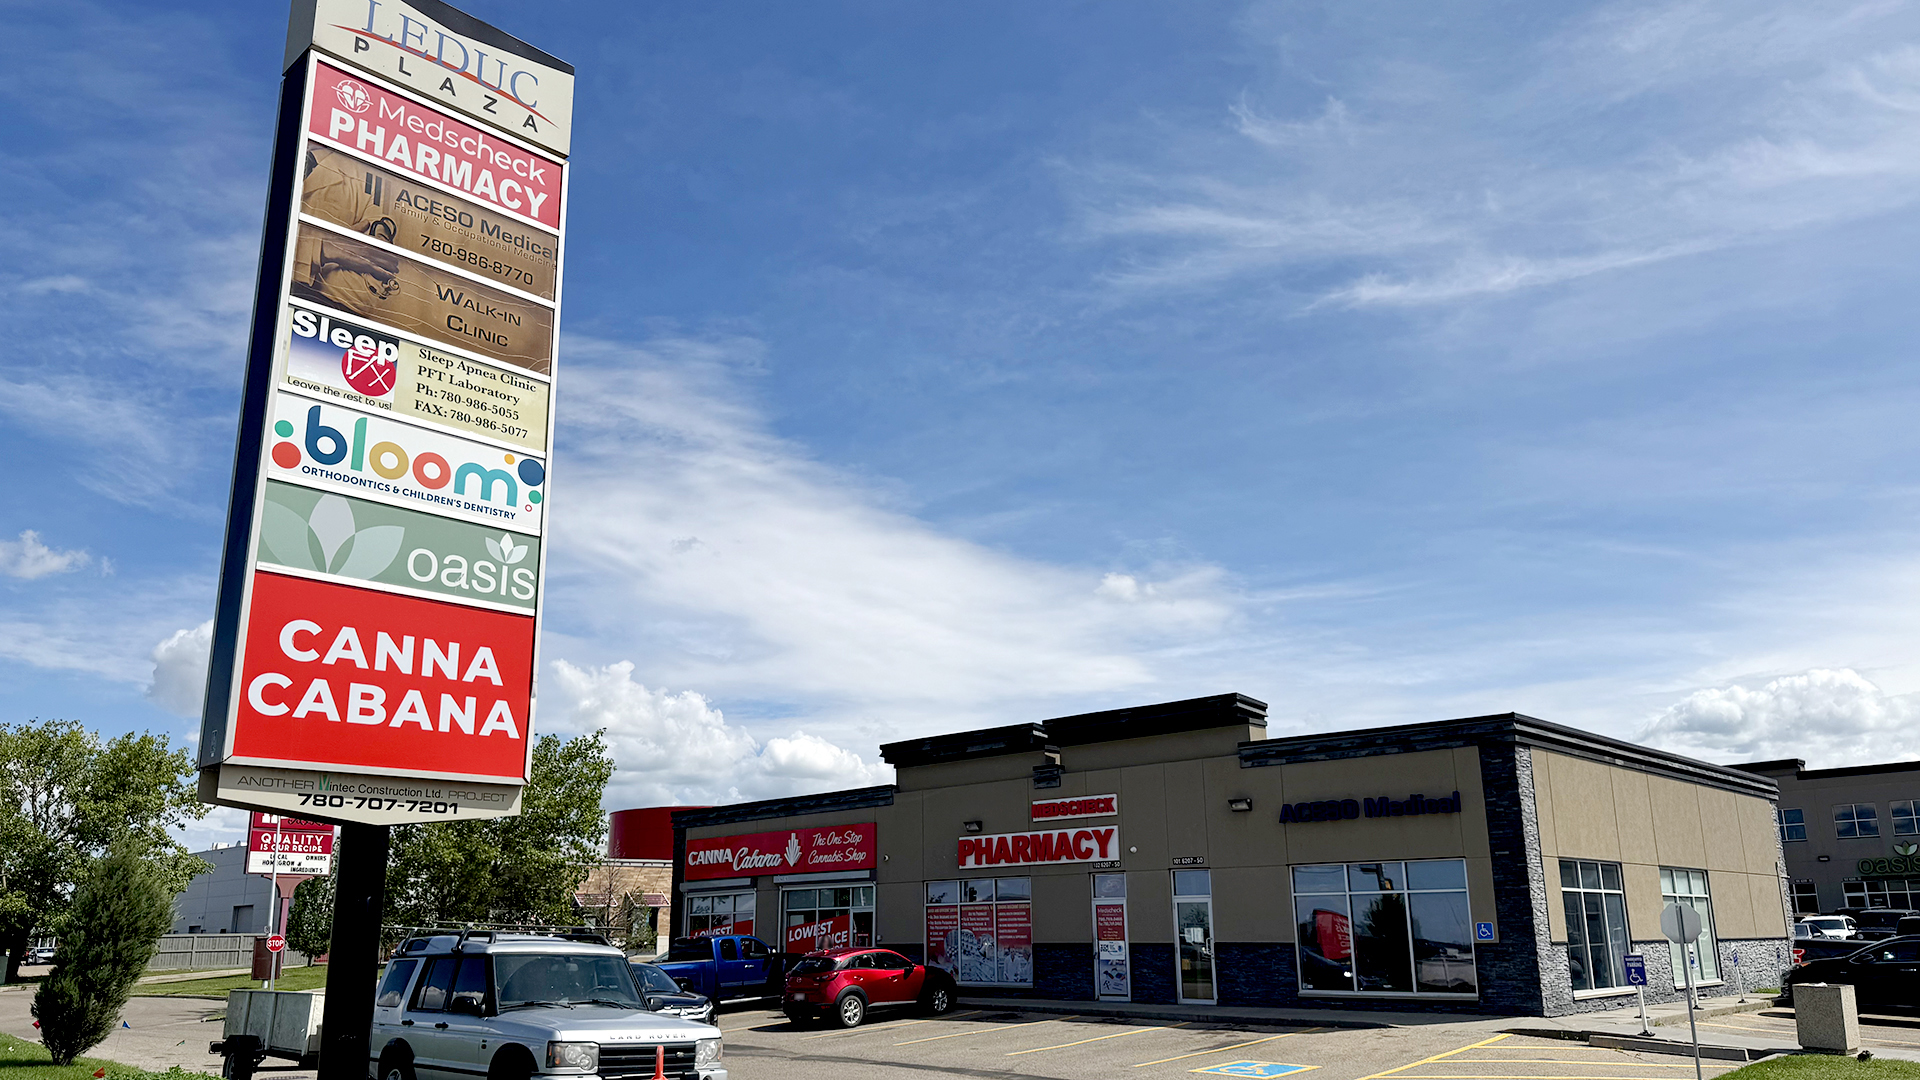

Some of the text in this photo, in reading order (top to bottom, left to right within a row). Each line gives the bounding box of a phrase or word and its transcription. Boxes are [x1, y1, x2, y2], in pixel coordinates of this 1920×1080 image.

[361, 0, 539, 108] LEDUC
[354, 36, 538, 133] PLAZA
[379, 97, 546, 186] Medscheck
[329, 107, 548, 219] PHARMACY
[396, 189, 474, 229] ACESO
[394, 202, 556, 270] Family & Occupational Medicine
[420, 234, 533, 285] 780-986-8770
[435, 284, 521, 326] WALK-IN
[292, 310, 399, 365] Sleep
[446, 314, 509, 347] CLINIC
[417, 365, 521, 405] PFT Laboratory
[419, 348, 537, 393] Sleep Apnea Clinic
[287, 376, 393, 411] Leave the rest to us!
[416, 383, 520, 421] Ph: 780-986-5055
[414, 400, 528, 439] FAX: 780-986-5077
[305, 405, 518, 507] bloom
[301, 465, 517, 520] ORTHODONTICS & CHILDREN'S DENTISTRY
[407, 547, 535, 600] oasis
[279, 619, 504, 686] CANNA
[247, 672, 520, 740] CABANA
[237, 774, 509, 803] ANOTHER Vintec Construction Ltd. PROJECT
[297, 793, 459, 815] 780-707-7201
[1279, 790, 1462, 824] ACESO Medical
[1031, 797, 1115, 820] MEDSCHECK
[260, 843, 268, 851] IS
[261, 833, 324, 846] QUALITY
[808, 847, 866, 864] Cannabis Shop
[813, 830, 863, 847] The One Stop
[958, 828, 1115, 867] PHARMACY
[688, 847, 783, 871] CANNA Cabana
[1857, 855, 1920, 875] oasis
[268, 939, 284, 947] STOP
[788, 920, 834, 942] LOWEST
